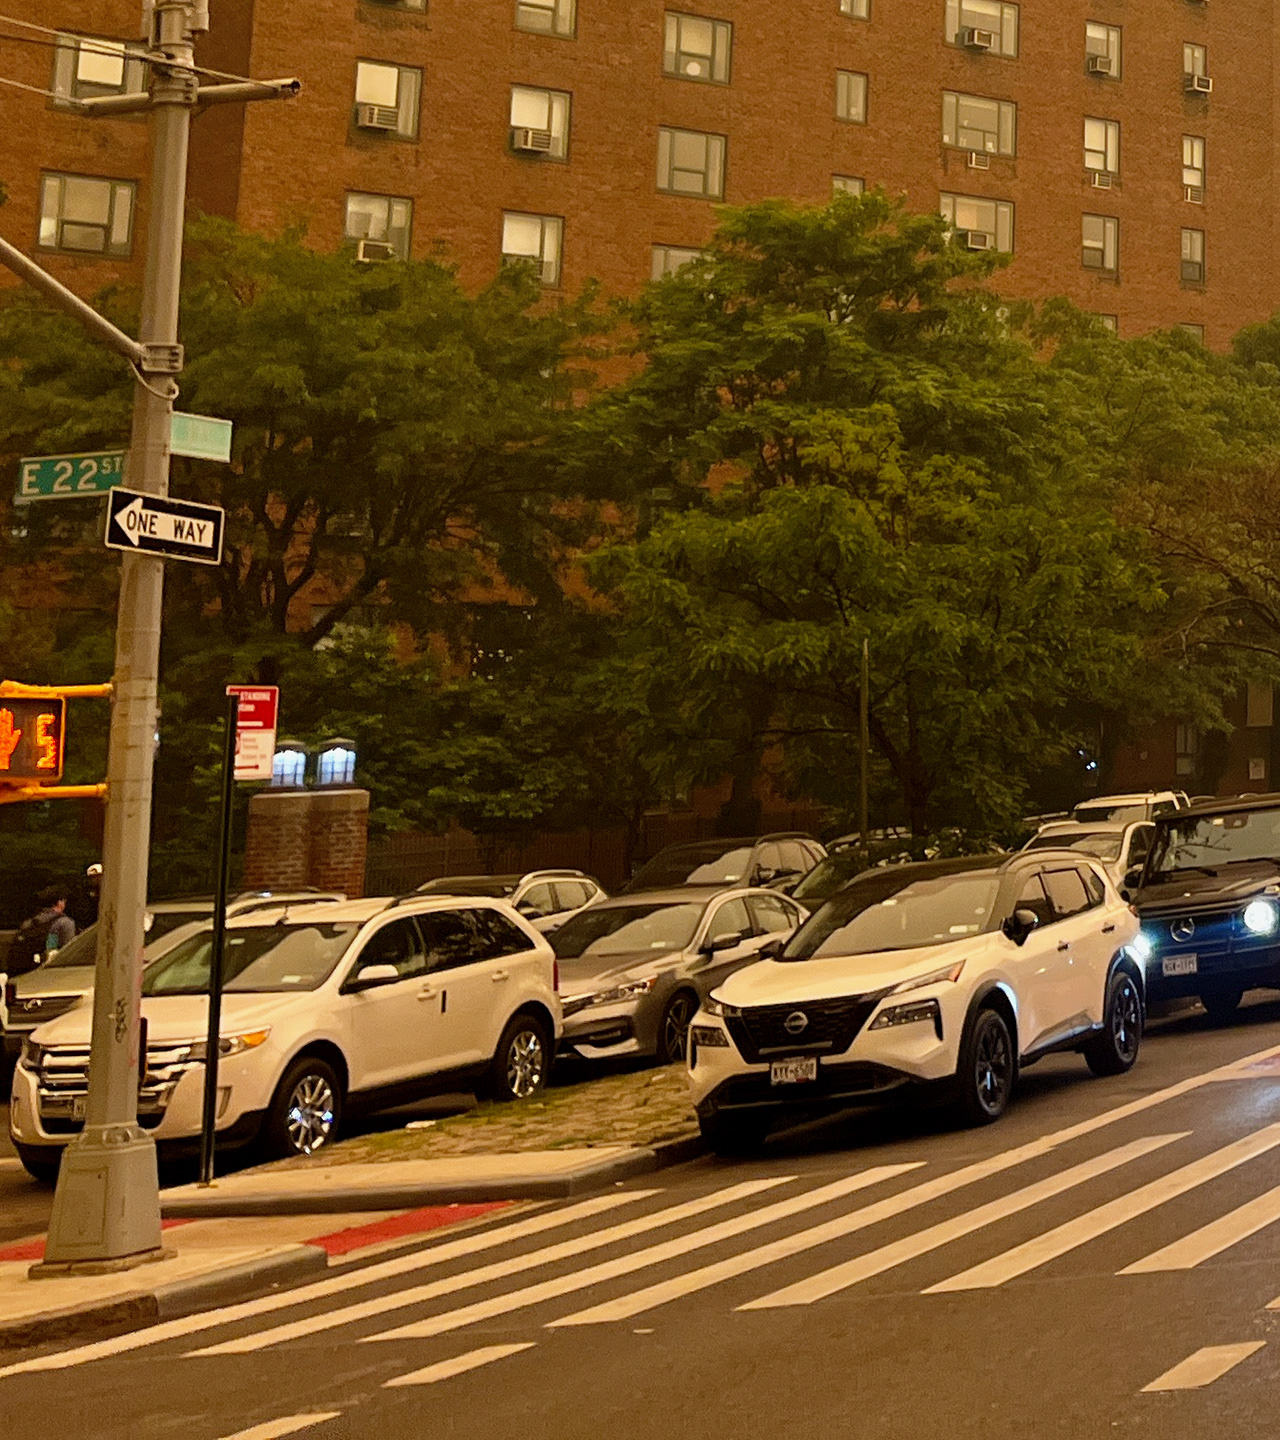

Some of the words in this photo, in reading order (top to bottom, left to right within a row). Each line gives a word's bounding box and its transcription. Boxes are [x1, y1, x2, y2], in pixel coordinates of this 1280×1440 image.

[22, 463, 42, 495] E
[53, 459, 98, 493] 22
[126, 510, 157, 535] ONE
[173, 518, 207, 543] WAY
[37, 713, 56, 769] 5
